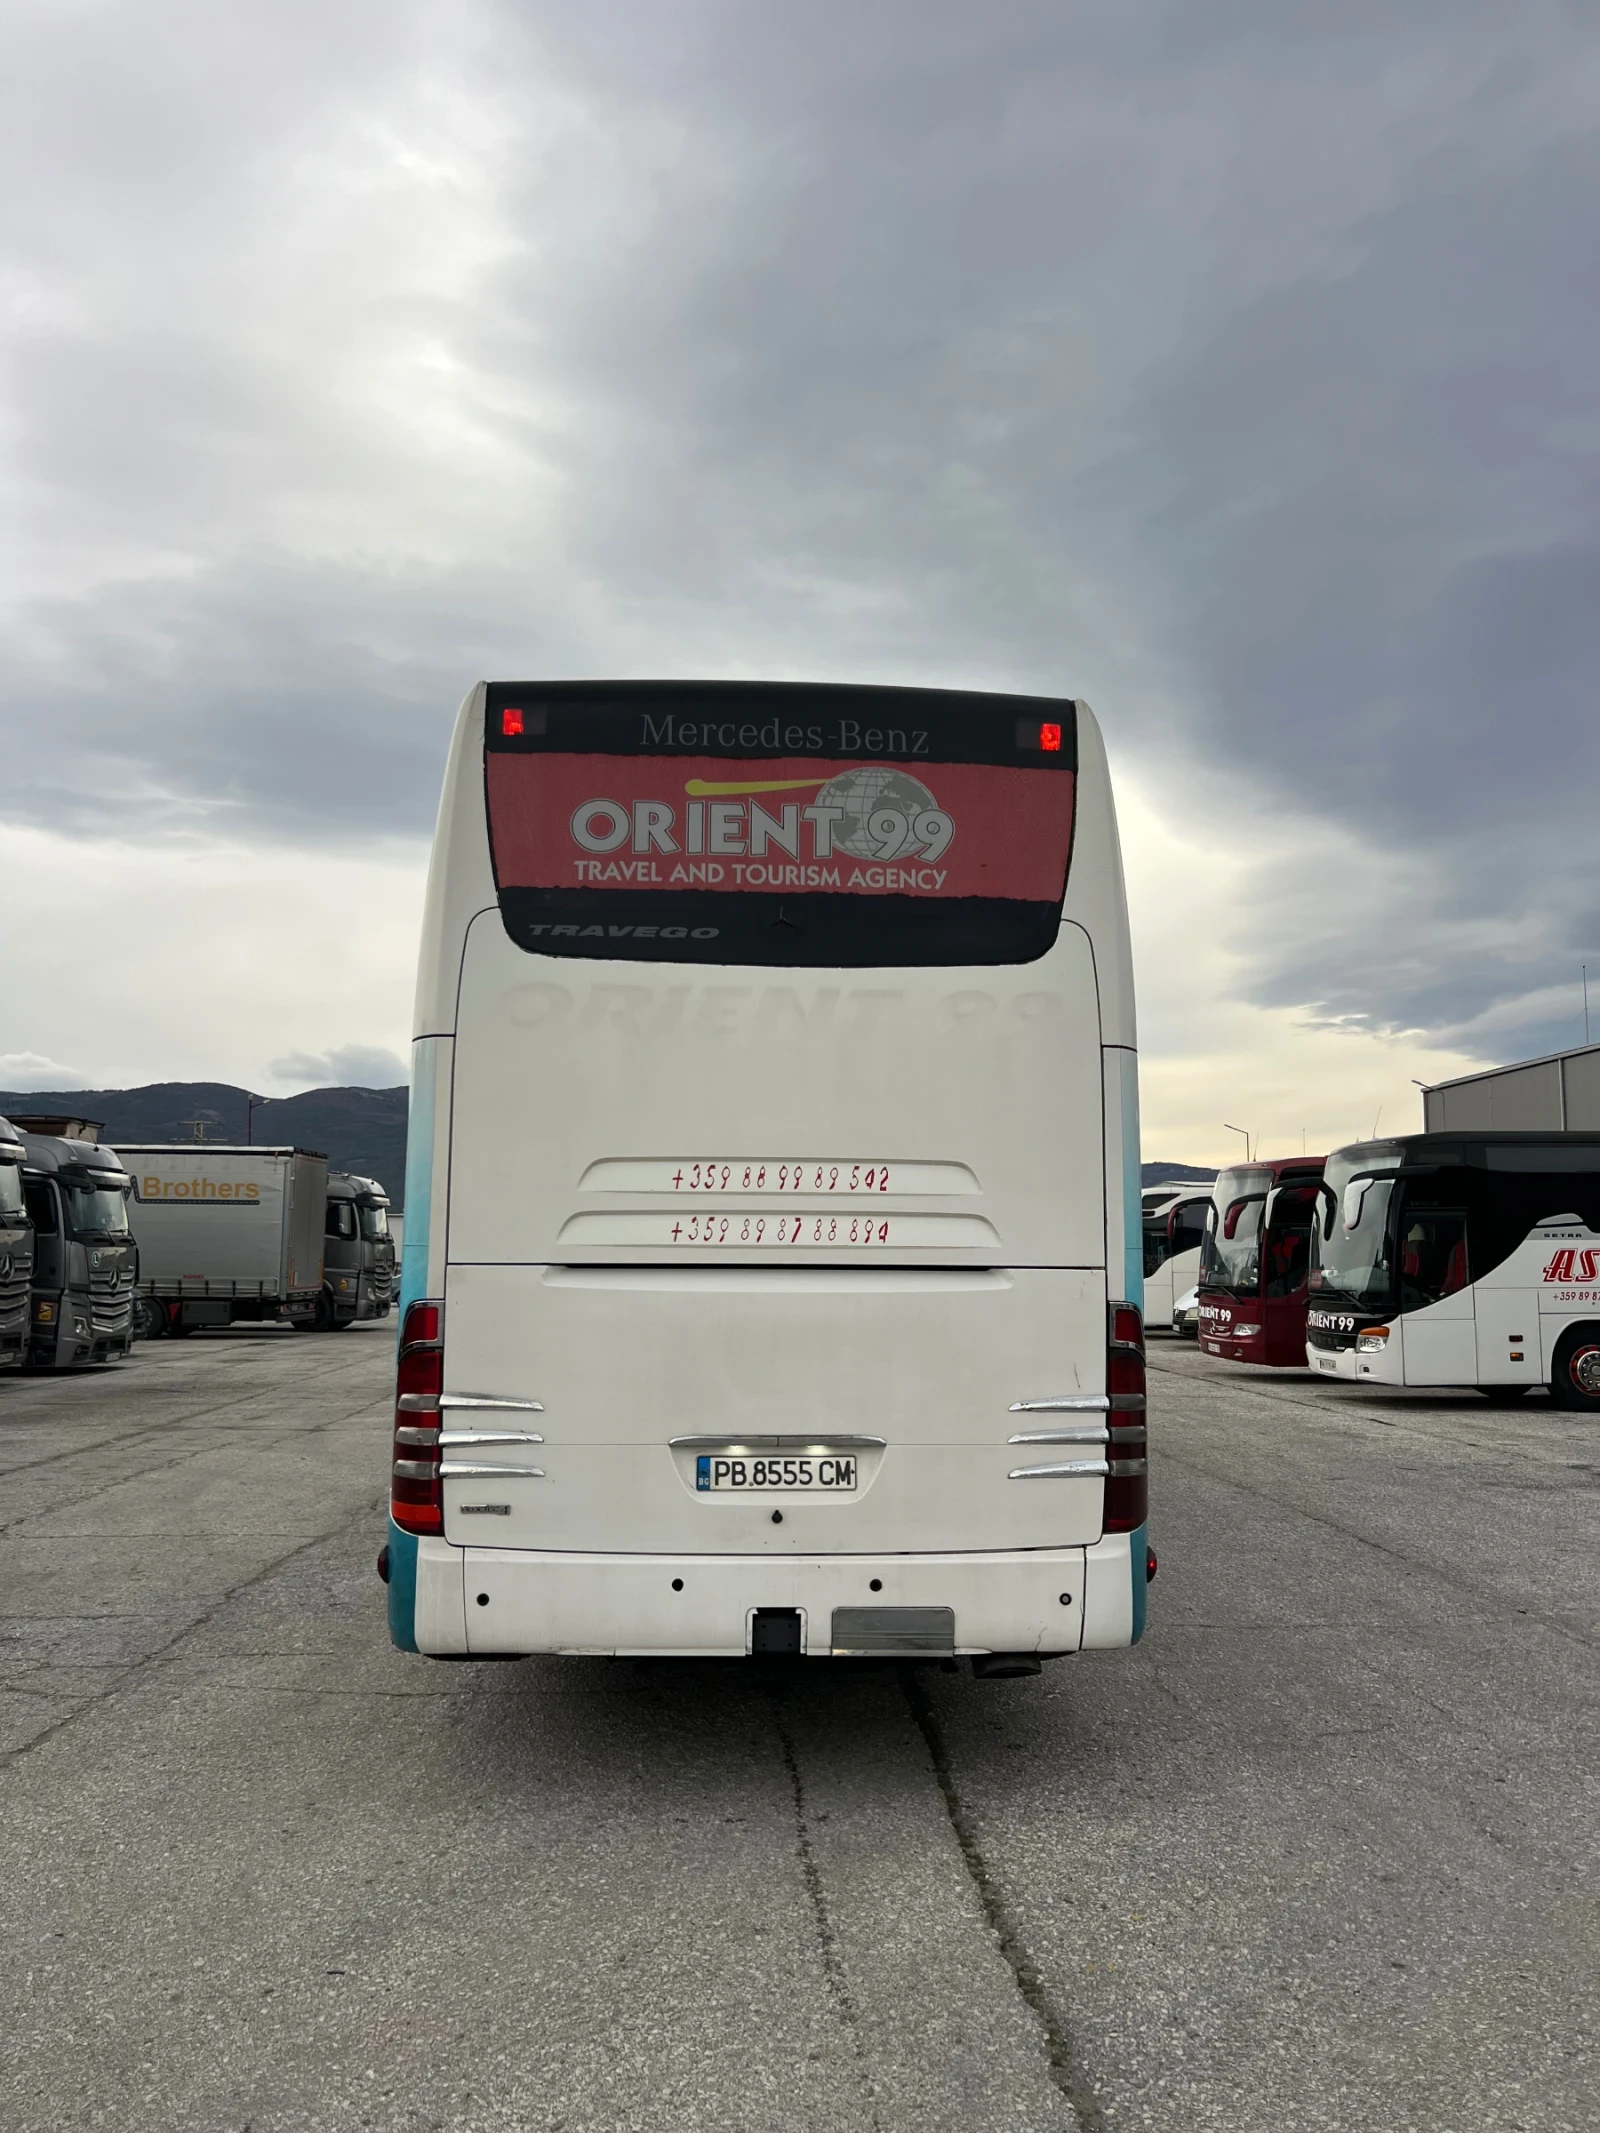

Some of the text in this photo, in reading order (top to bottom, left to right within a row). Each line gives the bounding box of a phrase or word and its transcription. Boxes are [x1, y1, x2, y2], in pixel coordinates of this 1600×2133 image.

[639, 714, 930, 754] Mercedes-Benz
[569, 797, 956, 864] ORIENT 99
[574, 860, 948, 890] TRAVEL AND TOURISM AGENCY
[528, 924, 720, 939] TRAVEGO
[142, 1176, 260, 1199] Brothers
[742, 1165, 767, 1189] 88
[778, 1164, 804, 1190] 99
[814, 1165, 840, 1190] 89
[849, 1165, 890, 1191] 542
[740, 1217, 766, 1243] 89
[776, 1217, 803, 1243] 87
[813, 1218, 838, 1242] 88
[849, 1218, 890, 1244] 894
[1553, 1291, 1577, 1301] +359
[1220, 1309, 1232, 1322] 99
[1338, 1316, 1355, 1332] 99
[698, 1477, 709, 1485] BG
[714, 1460, 851, 1486] PB 8555 CM
